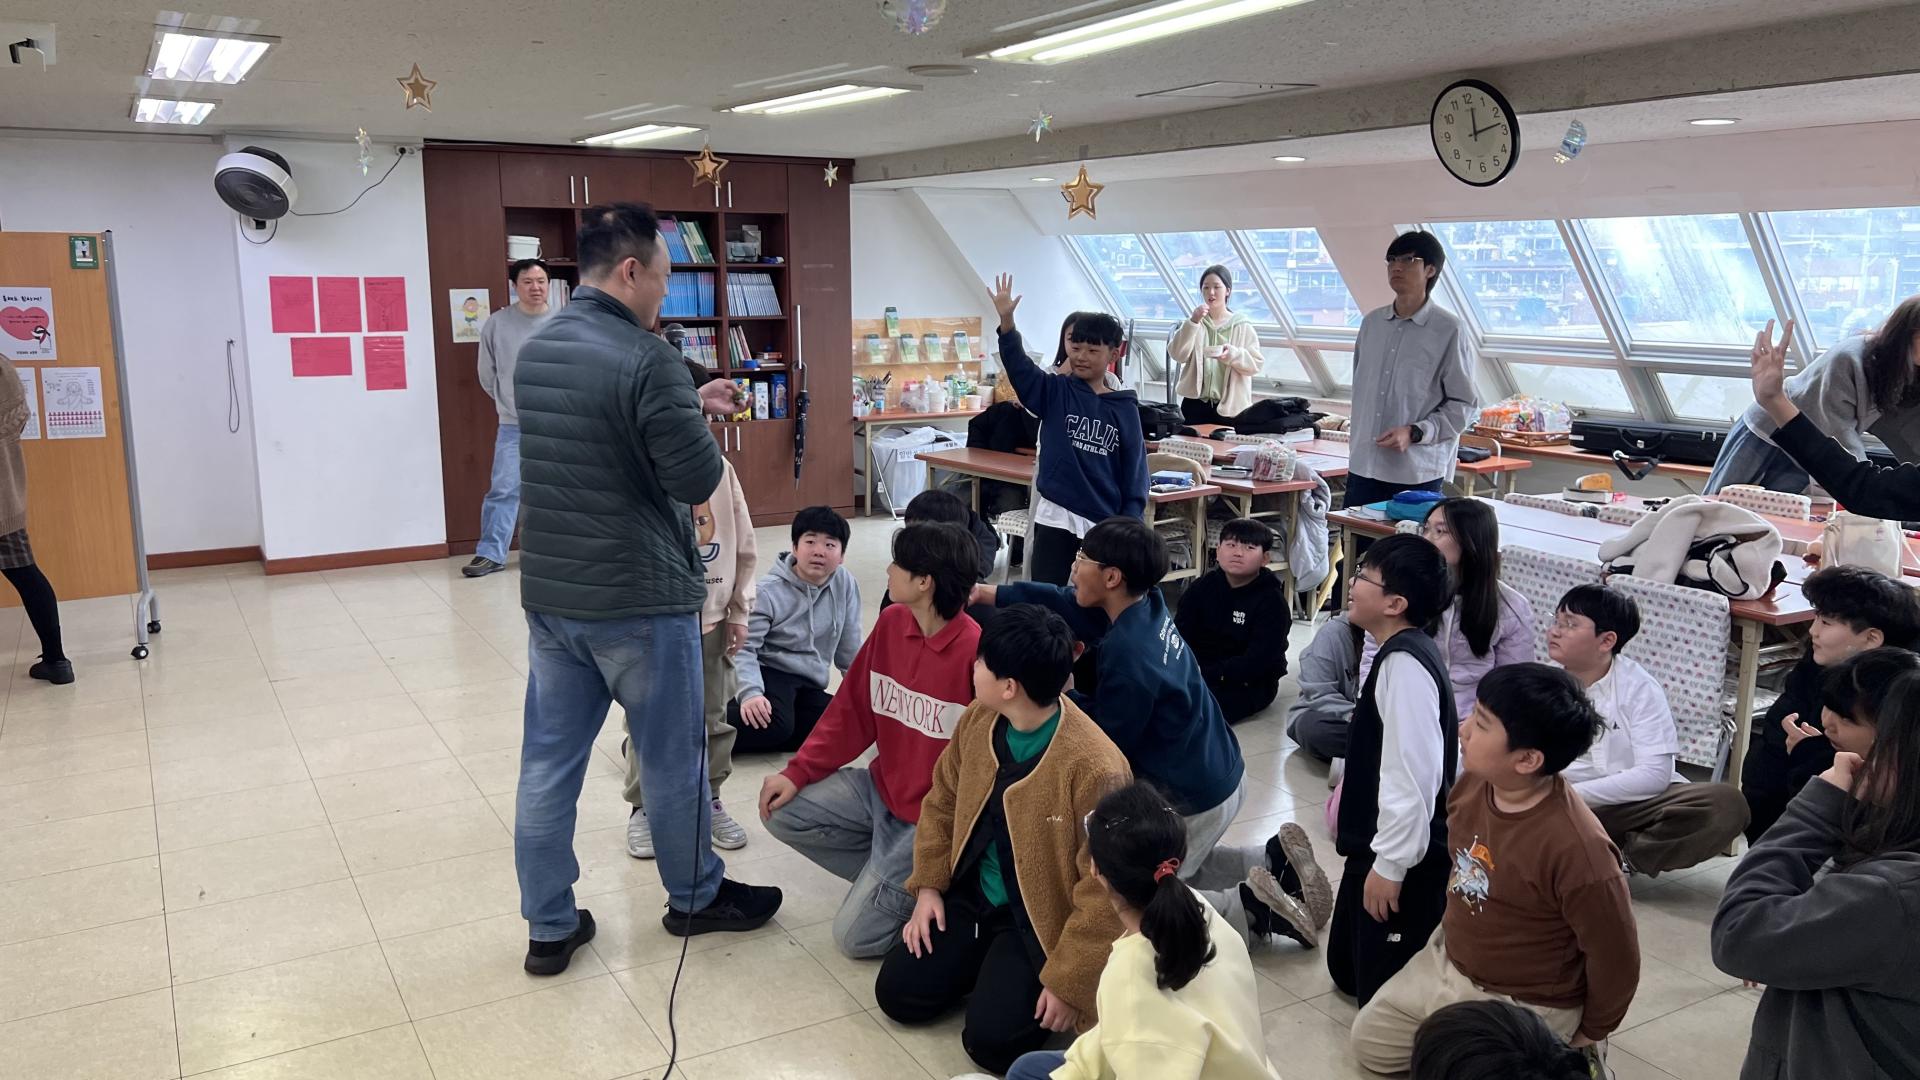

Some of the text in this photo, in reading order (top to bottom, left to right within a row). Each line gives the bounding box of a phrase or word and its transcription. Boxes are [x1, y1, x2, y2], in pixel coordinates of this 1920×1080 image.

[1462, 93, 1472, 105] 12
[1480, 97, 1486, 107] 1
[1451, 100, 1459, 111] 11
[1492, 107, 1500, 118] 2
[1444, 113, 1454, 125] 10
[1501, 124, 1508, 136] 3
[1444, 131, 1451, 142] 9
[1501, 143, 1507, 154] 4
[1453, 149, 1460, 160] 8
[1466, 159, 1472, 170] 7
[1493, 155, 1500, 167] 5
[1480, 161, 1487, 173] 6
[873, 679, 945, 733] NEW YORK
